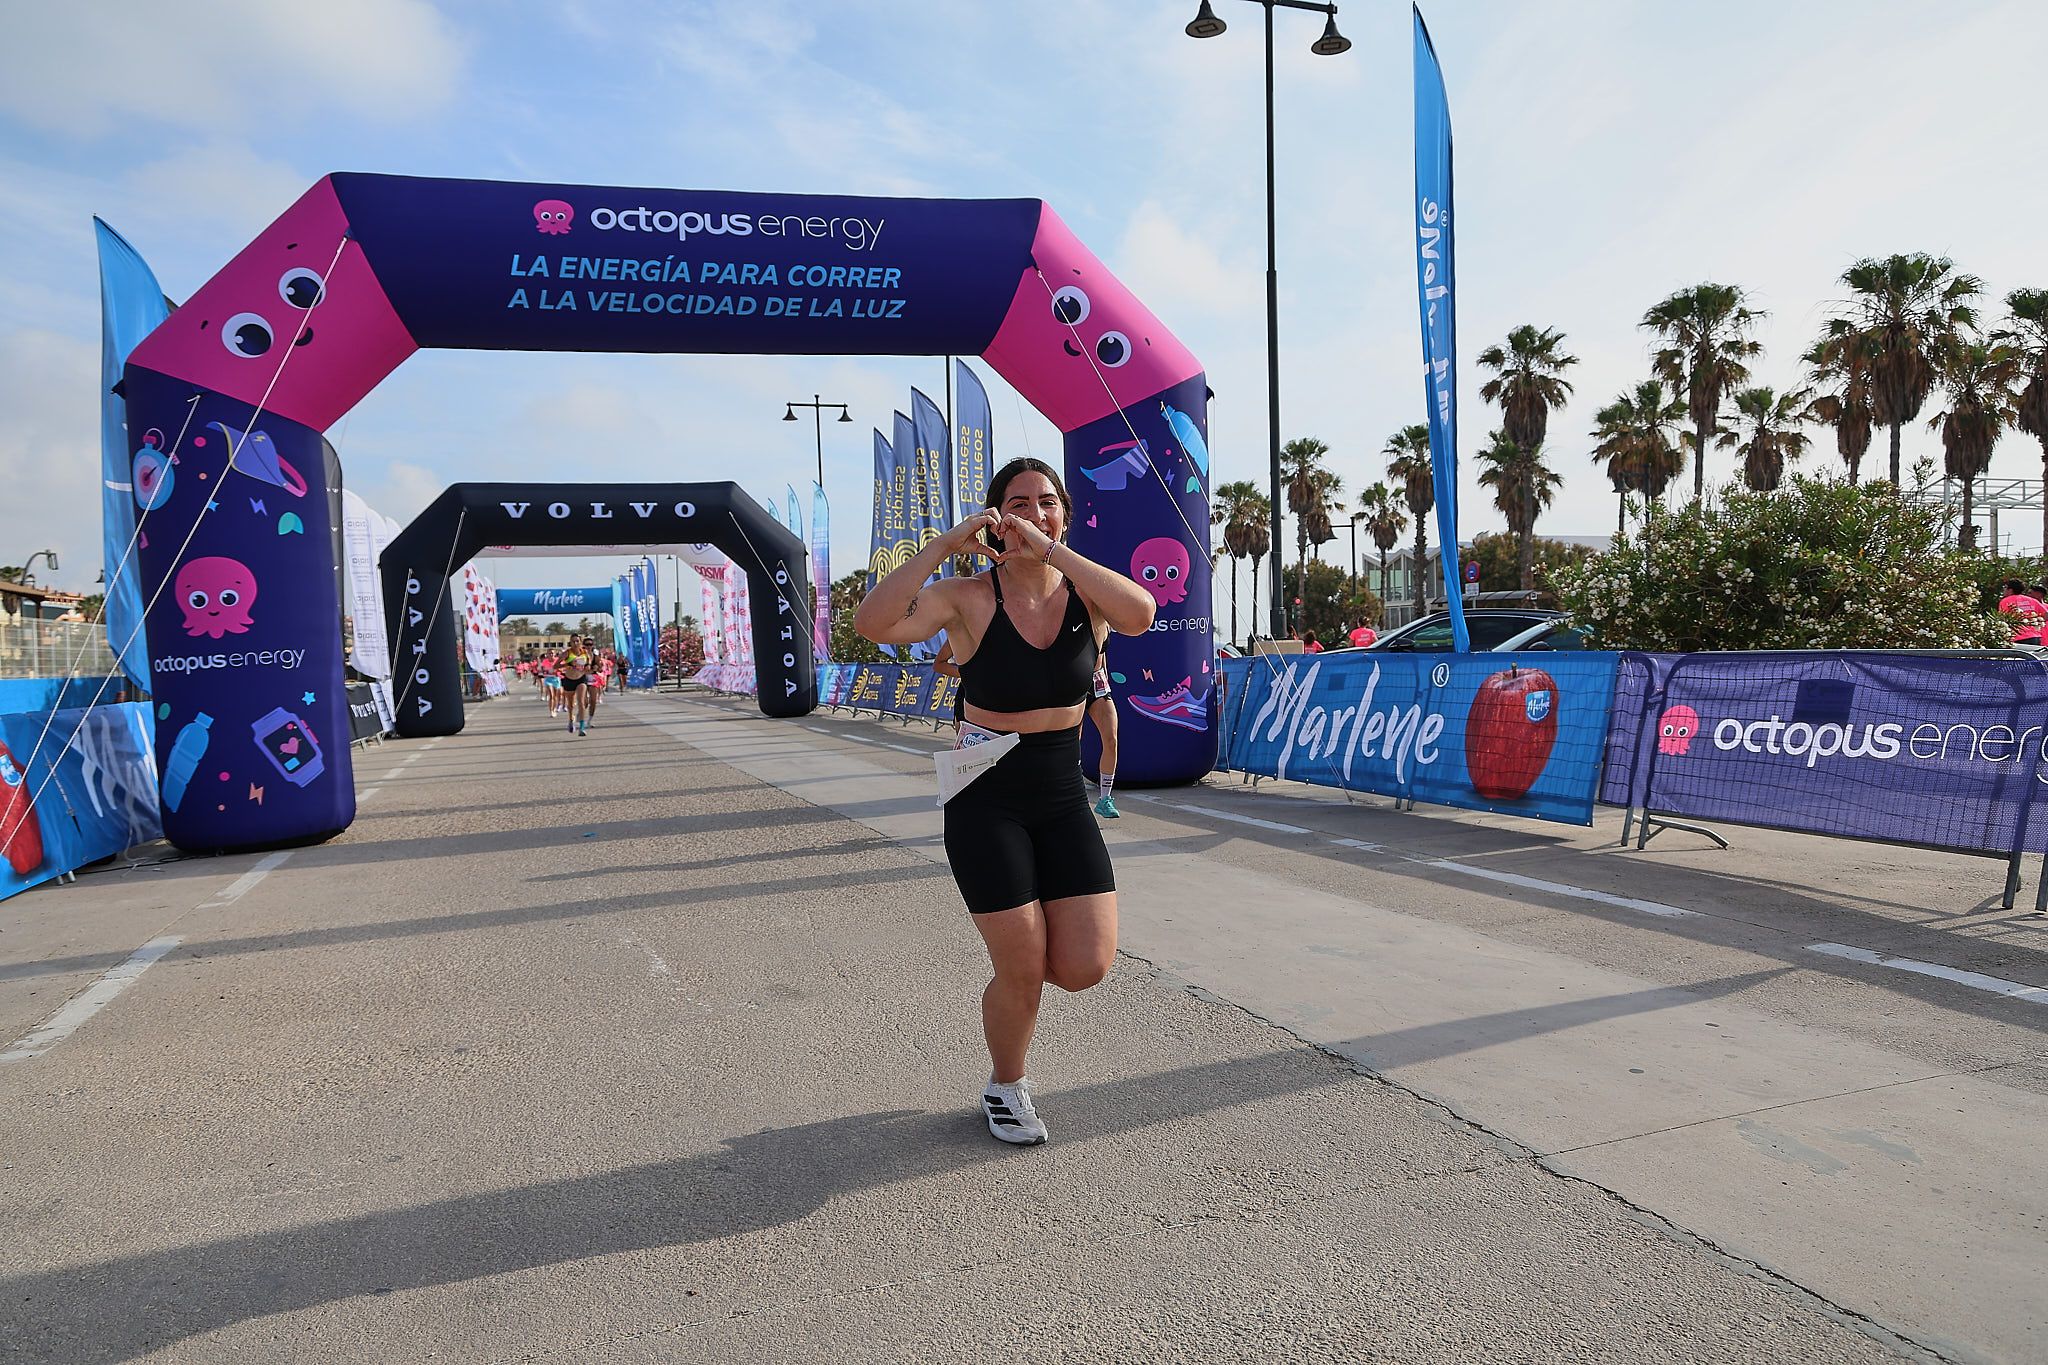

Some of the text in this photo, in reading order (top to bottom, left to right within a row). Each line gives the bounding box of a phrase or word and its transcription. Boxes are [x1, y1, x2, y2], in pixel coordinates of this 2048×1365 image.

[590, 206, 885, 251] octopus energy
[510, 253, 902, 289] LA ENERGÍA PARA CORRER
[508, 288, 906, 319] A LA VELOCIDAD DE LA LUZ
[500, 501, 696, 519] VOLVO
[534, 590, 584, 612] Marlene
[776, 570, 798, 698] VOLVO
[1170, 616, 1210, 634] energy
[154, 648, 306, 675] octopus energy
[406, 578, 433, 718] VOLVO
[1250, 660, 1445, 784] Marlene
[1713, 714, 2048, 785] octopus ener
